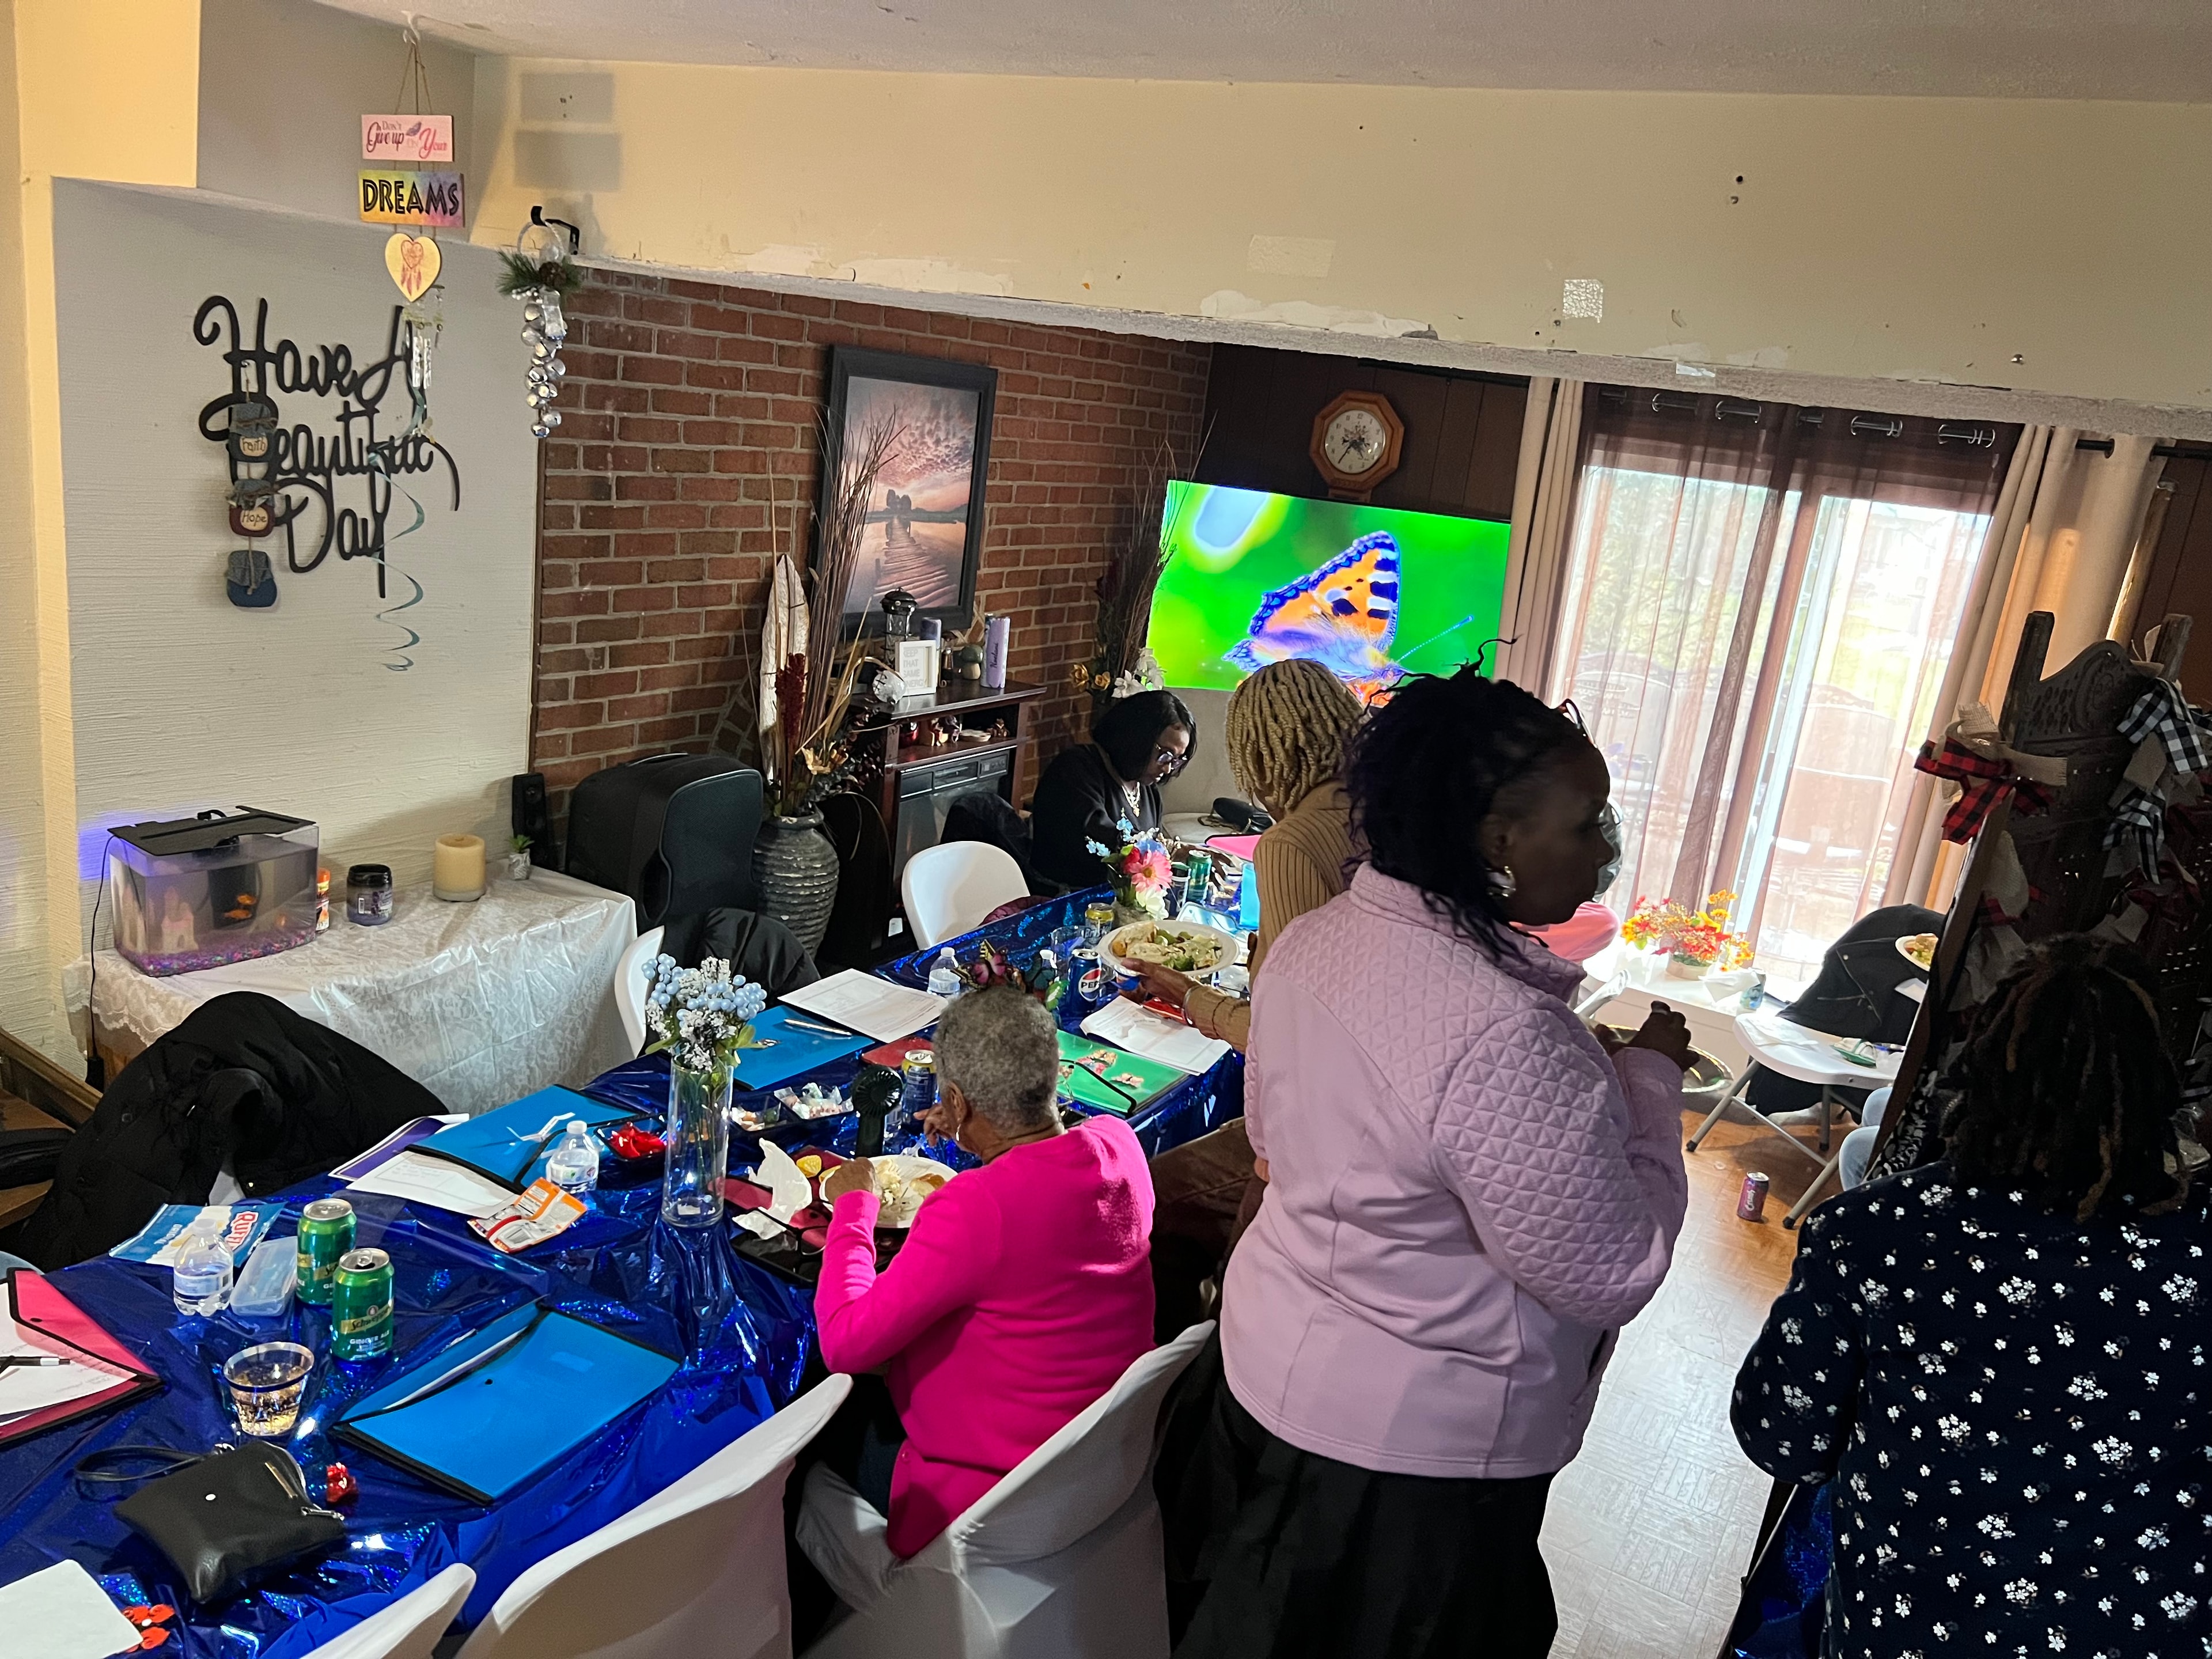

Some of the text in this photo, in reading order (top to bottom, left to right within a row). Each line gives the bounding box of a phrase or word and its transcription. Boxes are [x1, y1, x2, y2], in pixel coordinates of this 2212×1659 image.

[392, 132, 404, 151] up
[419, 128, 448, 159] Your
[362, 179, 460, 217] DREAMS
[194, 296, 358, 397] Have
[242, 509, 267, 527] Hope
[271, 477, 388, 598] Day
